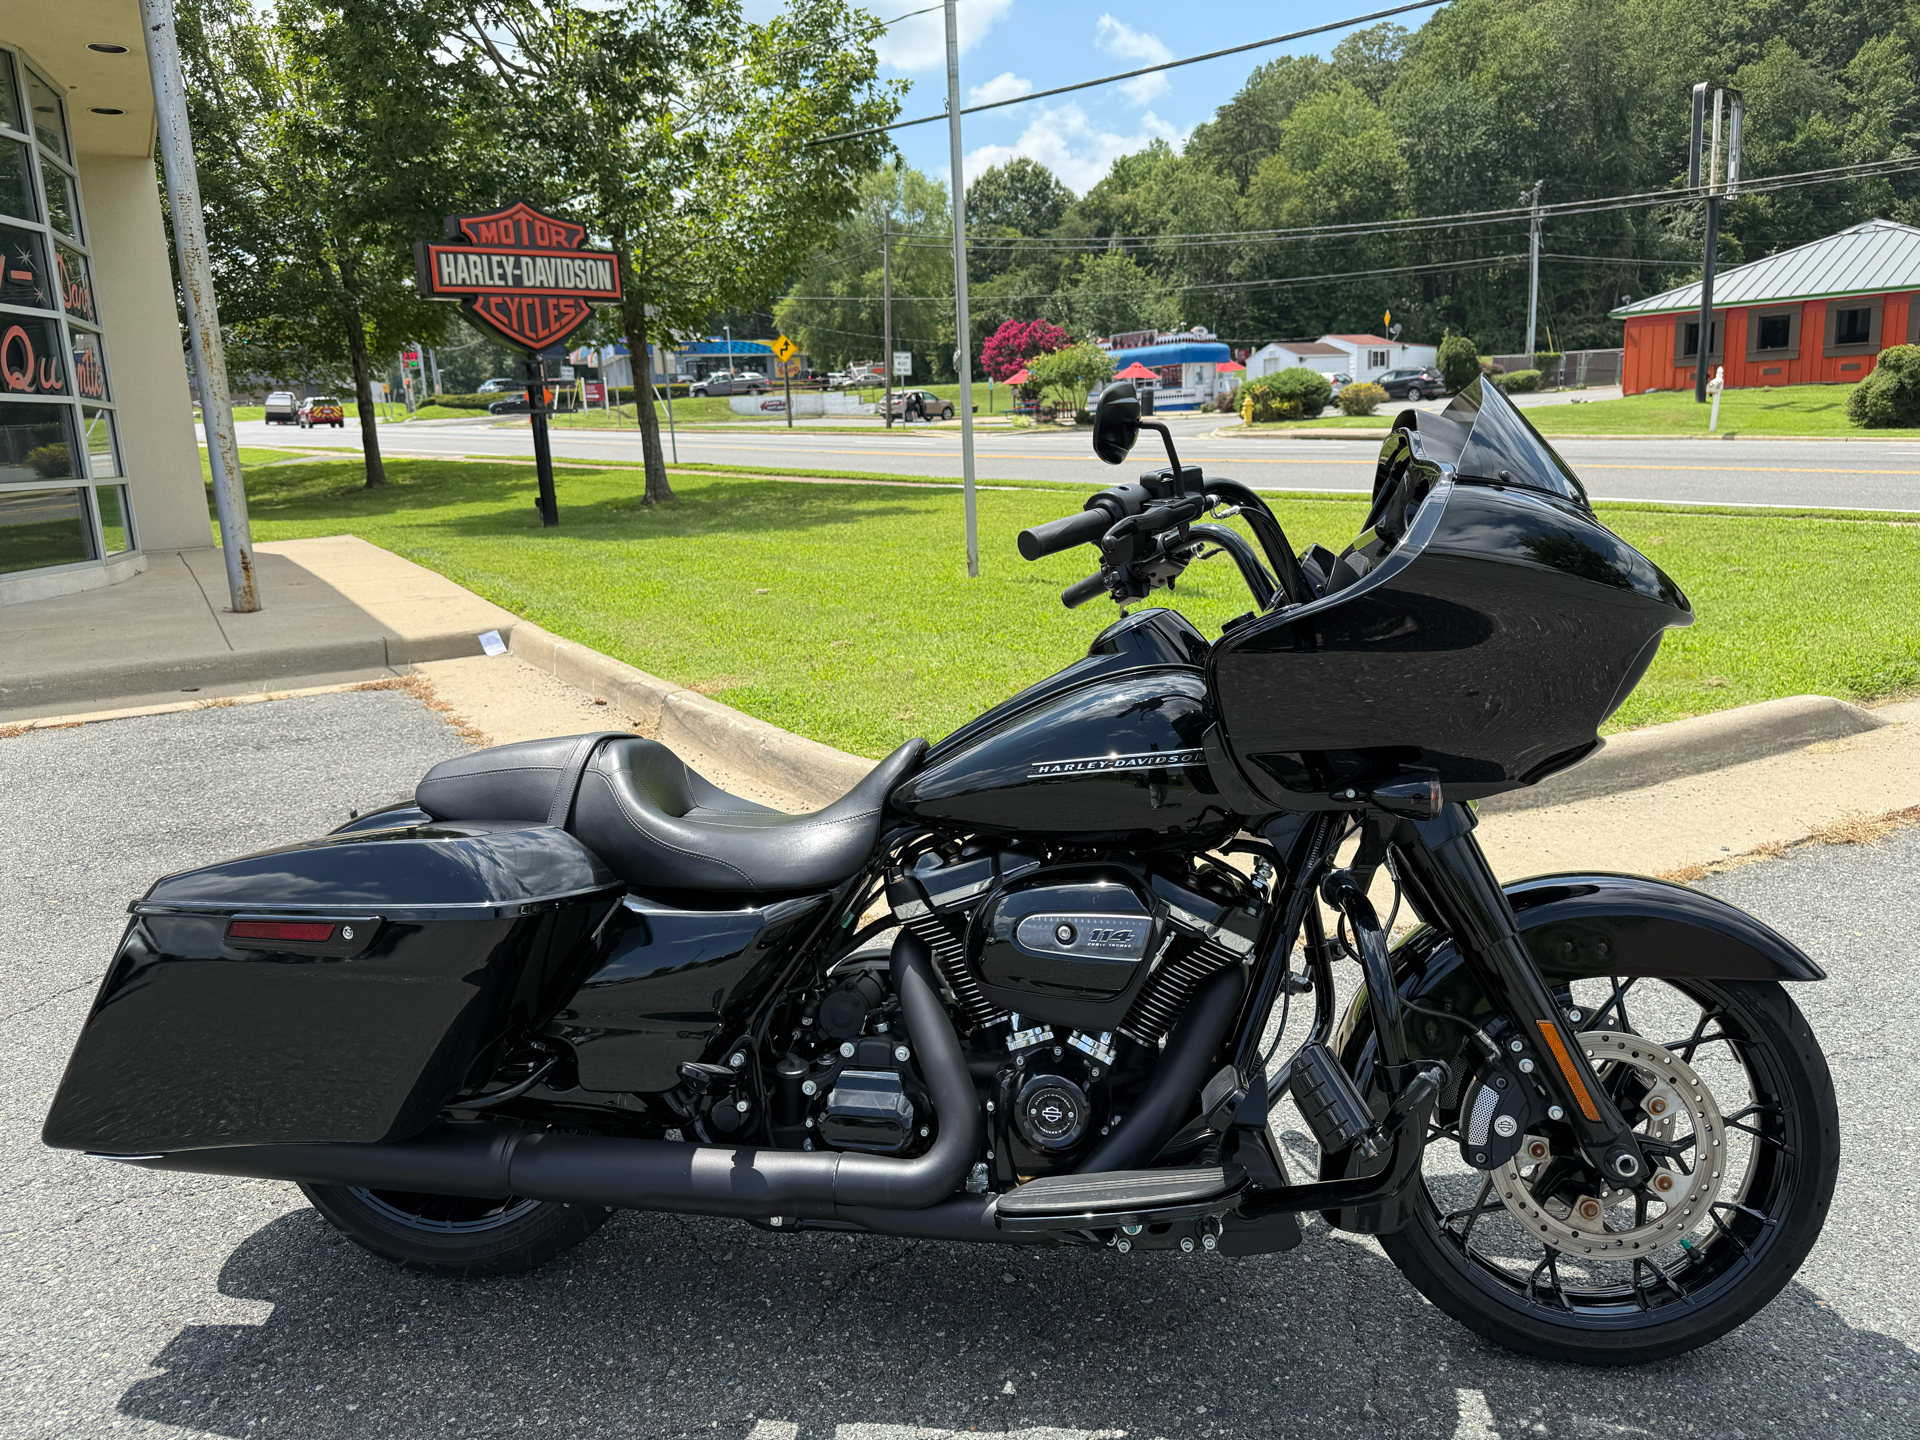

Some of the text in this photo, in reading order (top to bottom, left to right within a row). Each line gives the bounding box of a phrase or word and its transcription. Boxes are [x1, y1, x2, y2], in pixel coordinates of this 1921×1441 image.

[478, 210, 570, 249] MOTOR
[440, 253, 613, 291] HARLEY-DAVIDSON
[489, 296, 577, 341] CYCLES
[1038, 753, 1205, 774] HARLEY-DAVIDSON
[1089, 928, 1136, 944] 114
